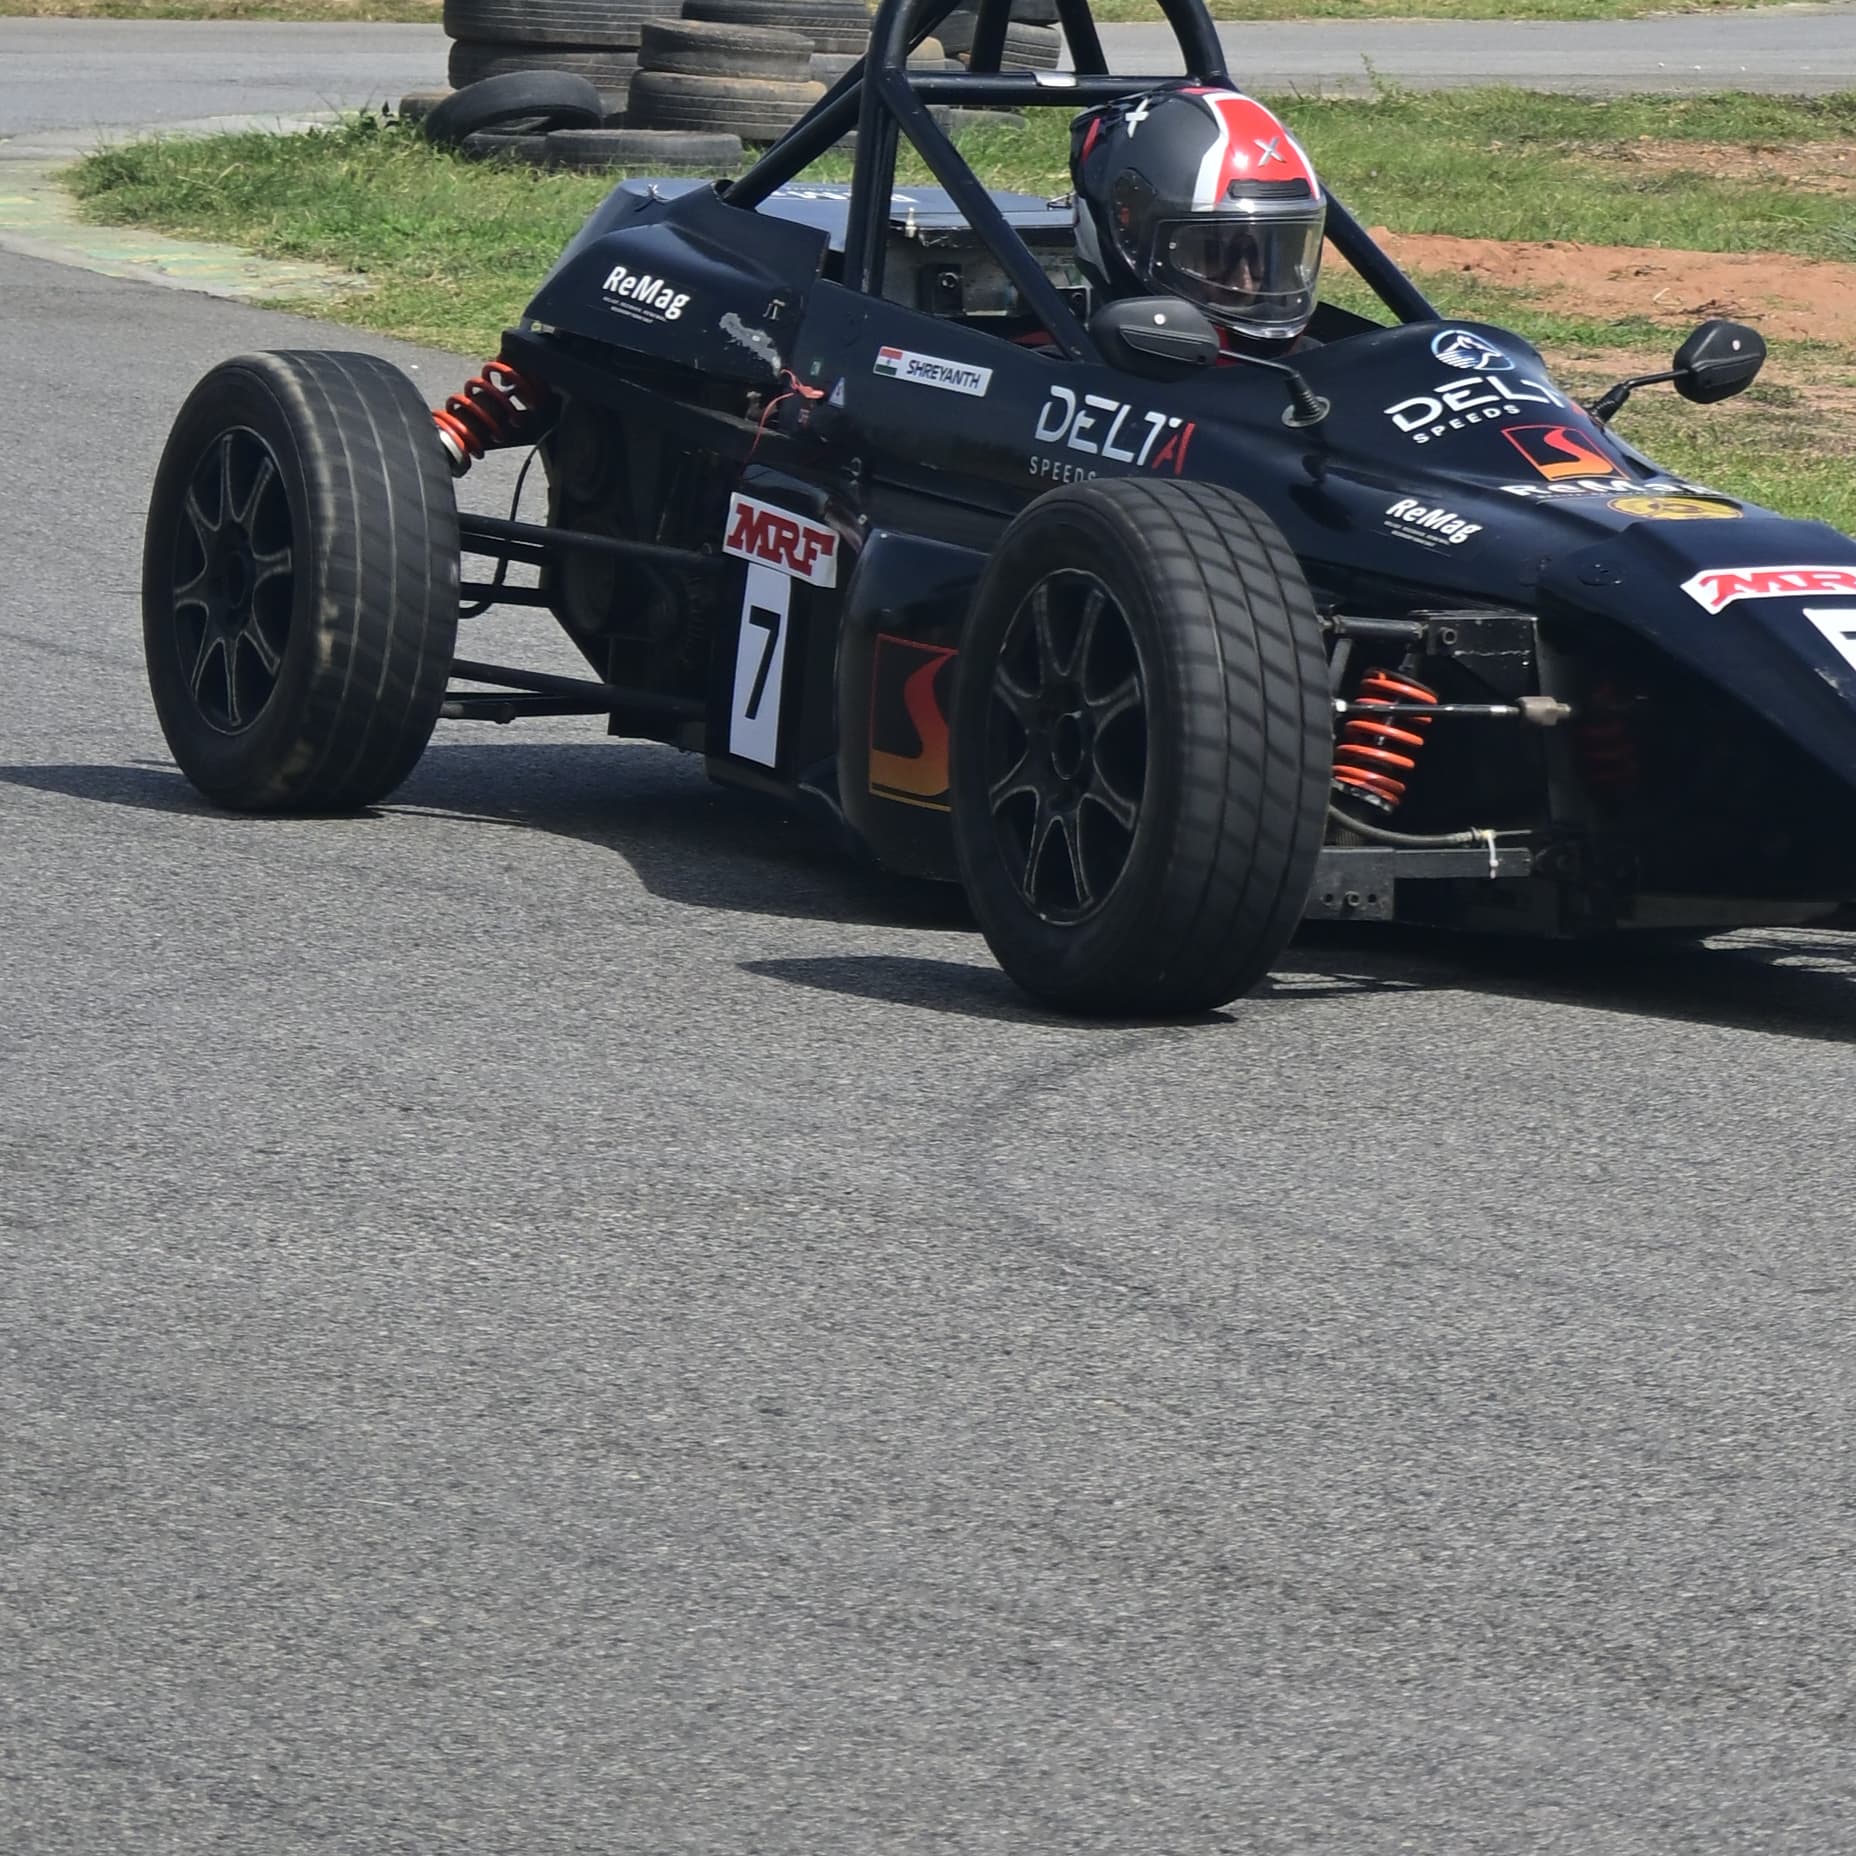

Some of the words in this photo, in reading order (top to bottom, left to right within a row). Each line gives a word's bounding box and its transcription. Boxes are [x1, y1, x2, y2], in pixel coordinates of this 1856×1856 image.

[602, 266, 691, 320] ReMag
[906, 360, 981, 389] SHREYANTH
[1035, 385, 1196, 476] DELTA
[1384, 376, 1587, 432] DELT
[1413, 405, 1520, 444] SPEEDS
[727, 503, 835, 576] MRF
[1385, 499, 1483, 543] ReMag
[745, 605, 781, 720] 7
